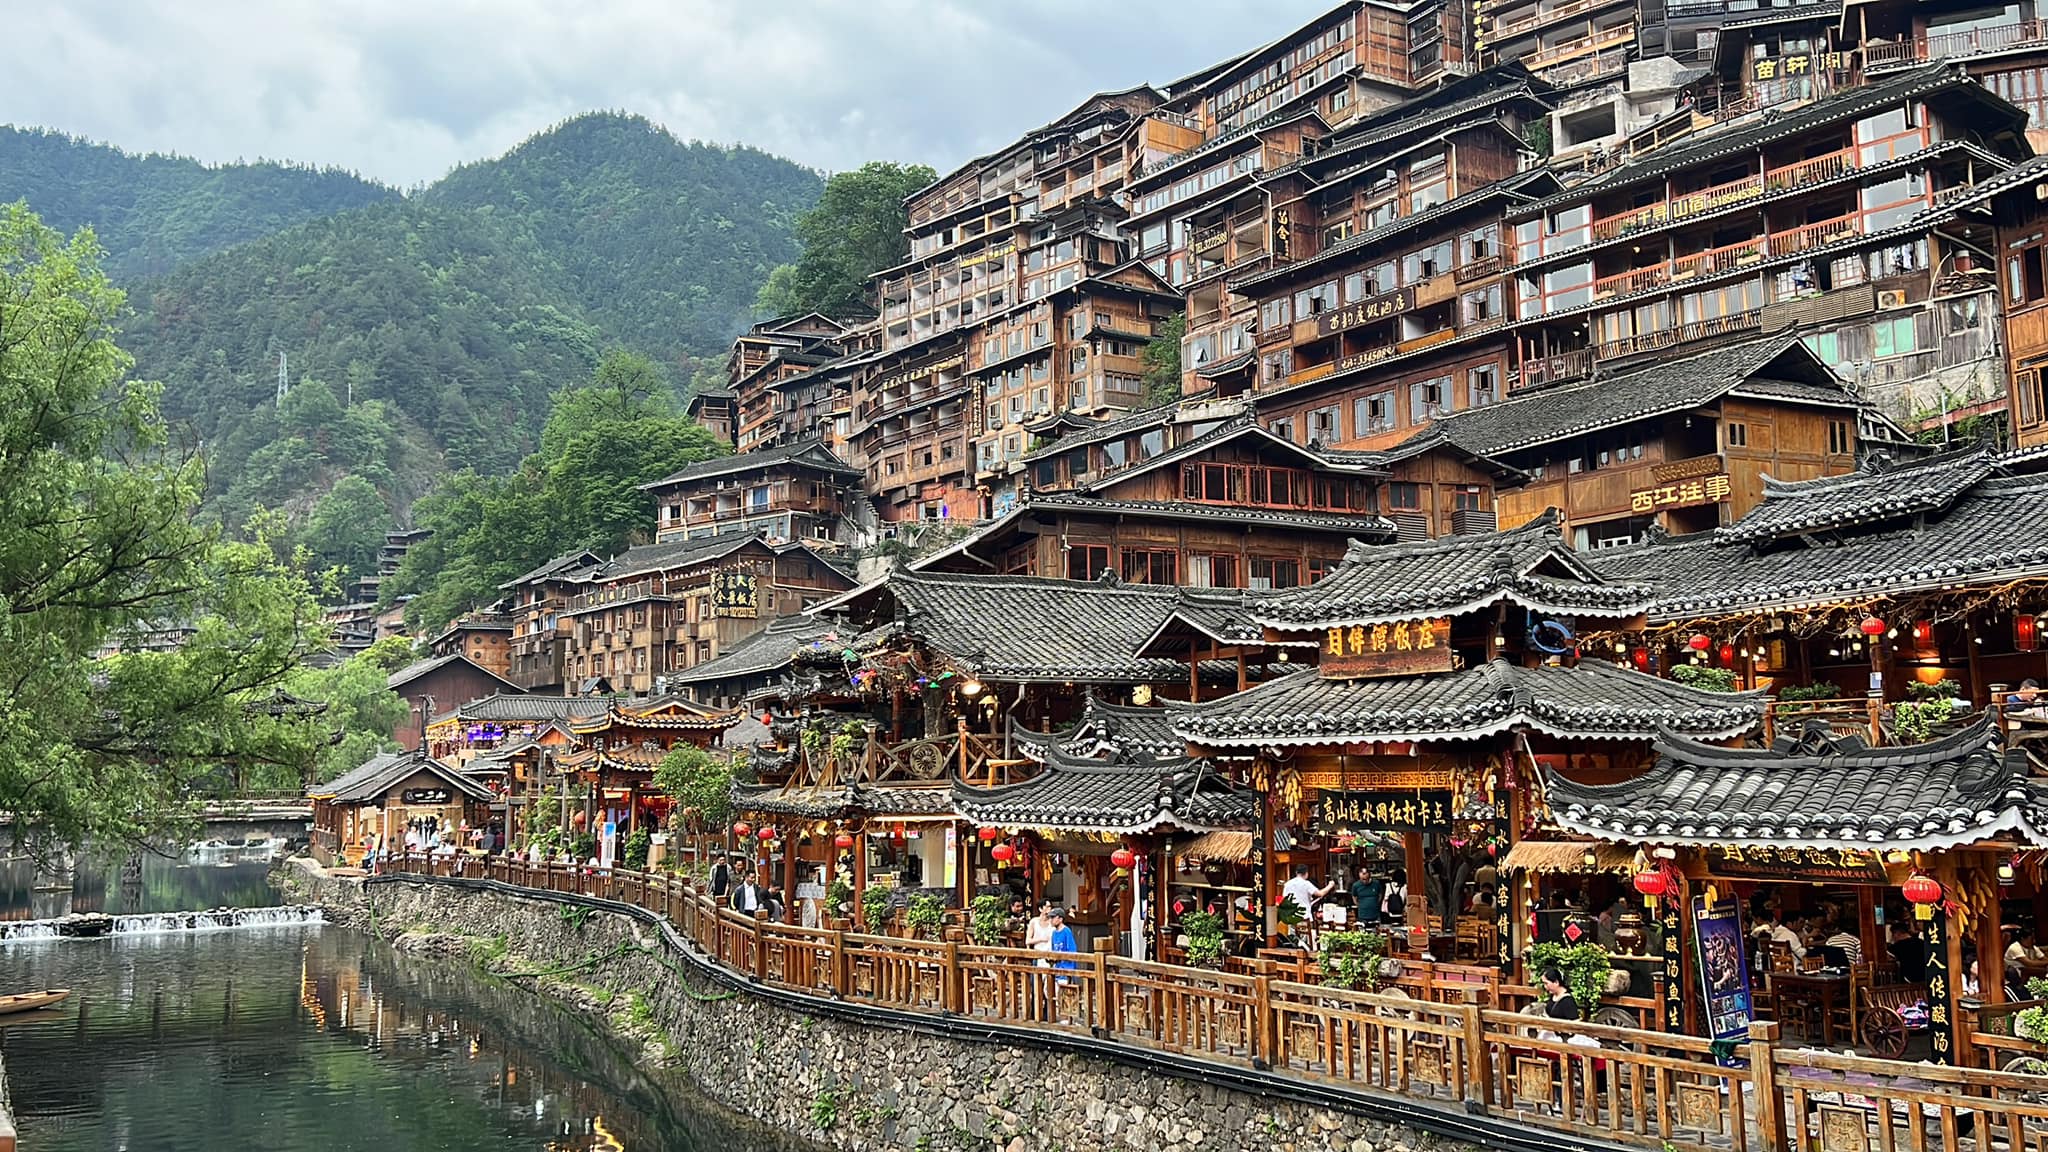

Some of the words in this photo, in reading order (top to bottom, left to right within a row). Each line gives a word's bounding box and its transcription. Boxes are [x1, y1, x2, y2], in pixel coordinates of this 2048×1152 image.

[1329, 292, 1406, 330] 苗韵度假酒店
[1630, 474, 1732, 512] 西江往事
[1323, 796, 1447, 828] 高山流水网红打卡点
